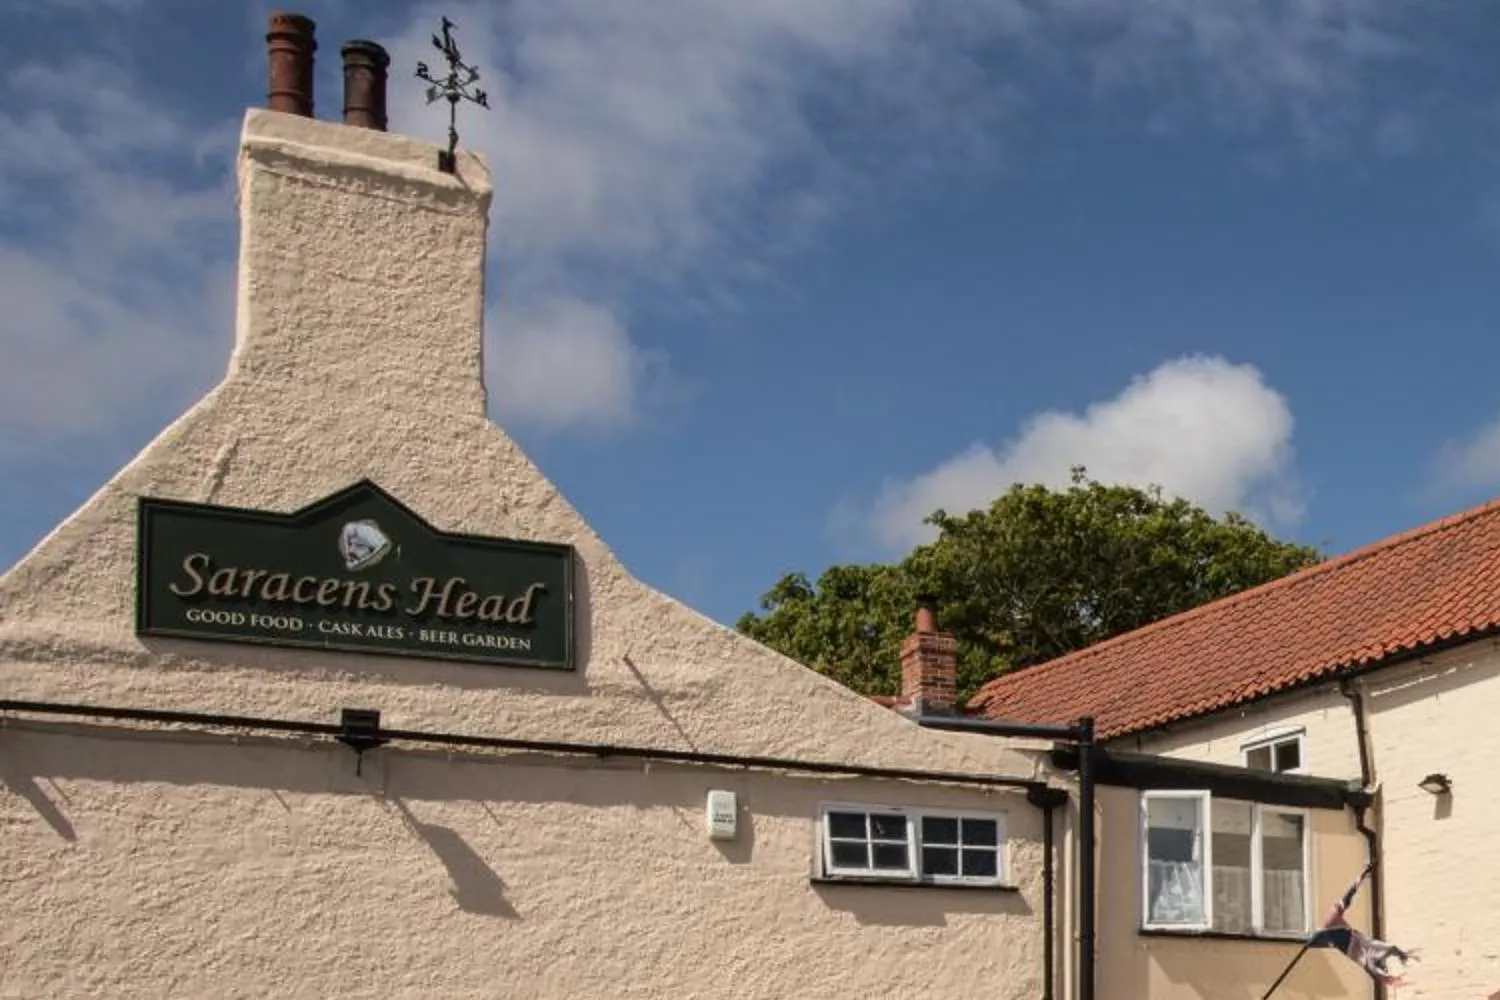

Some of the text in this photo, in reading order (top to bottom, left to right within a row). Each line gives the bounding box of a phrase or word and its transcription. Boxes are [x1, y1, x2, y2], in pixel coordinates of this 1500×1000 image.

[169, 552, 546, 625] Saracens Head
[185, 608, 532, 651] GOOD FOOD CASK ALES BEER GARDEN
